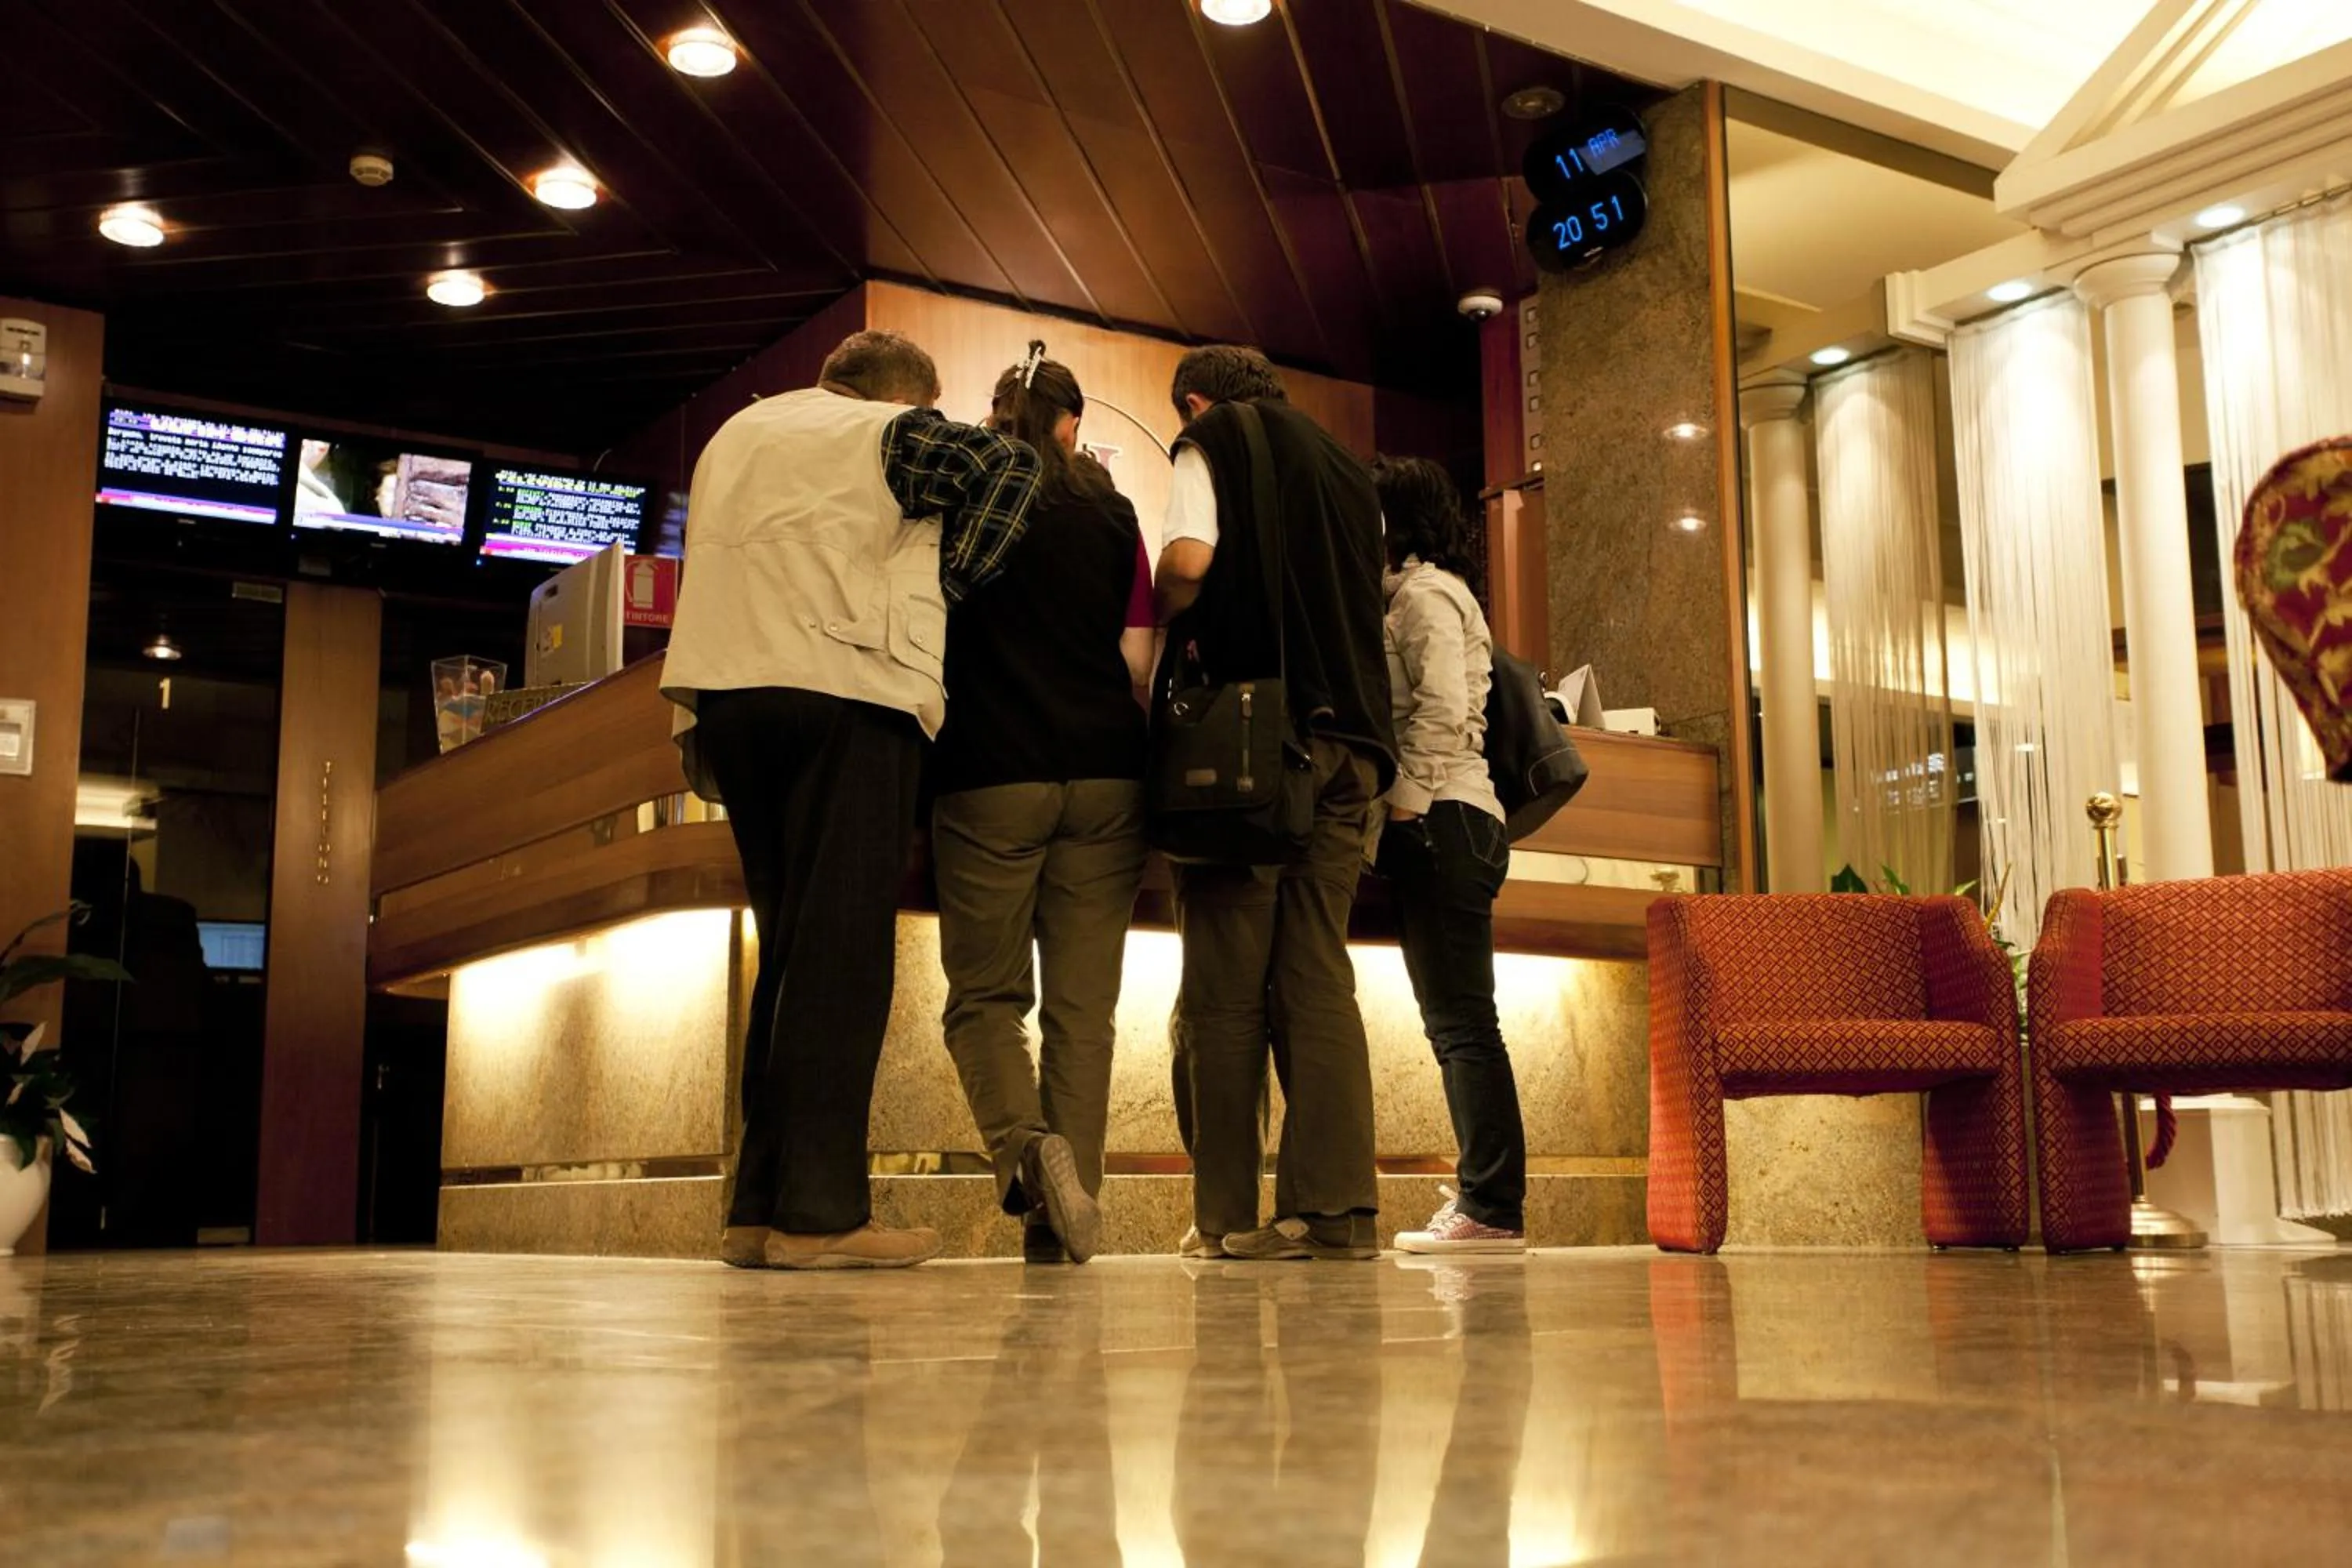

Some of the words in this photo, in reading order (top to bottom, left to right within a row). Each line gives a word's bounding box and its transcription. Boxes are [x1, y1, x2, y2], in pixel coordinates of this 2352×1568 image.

[1555, 147, 1584, 180] 11
[1587, 128, 1621, 158] APR
[1552, 216, 1583, 250] 20
[1590, 195, 1624, 230] 51
